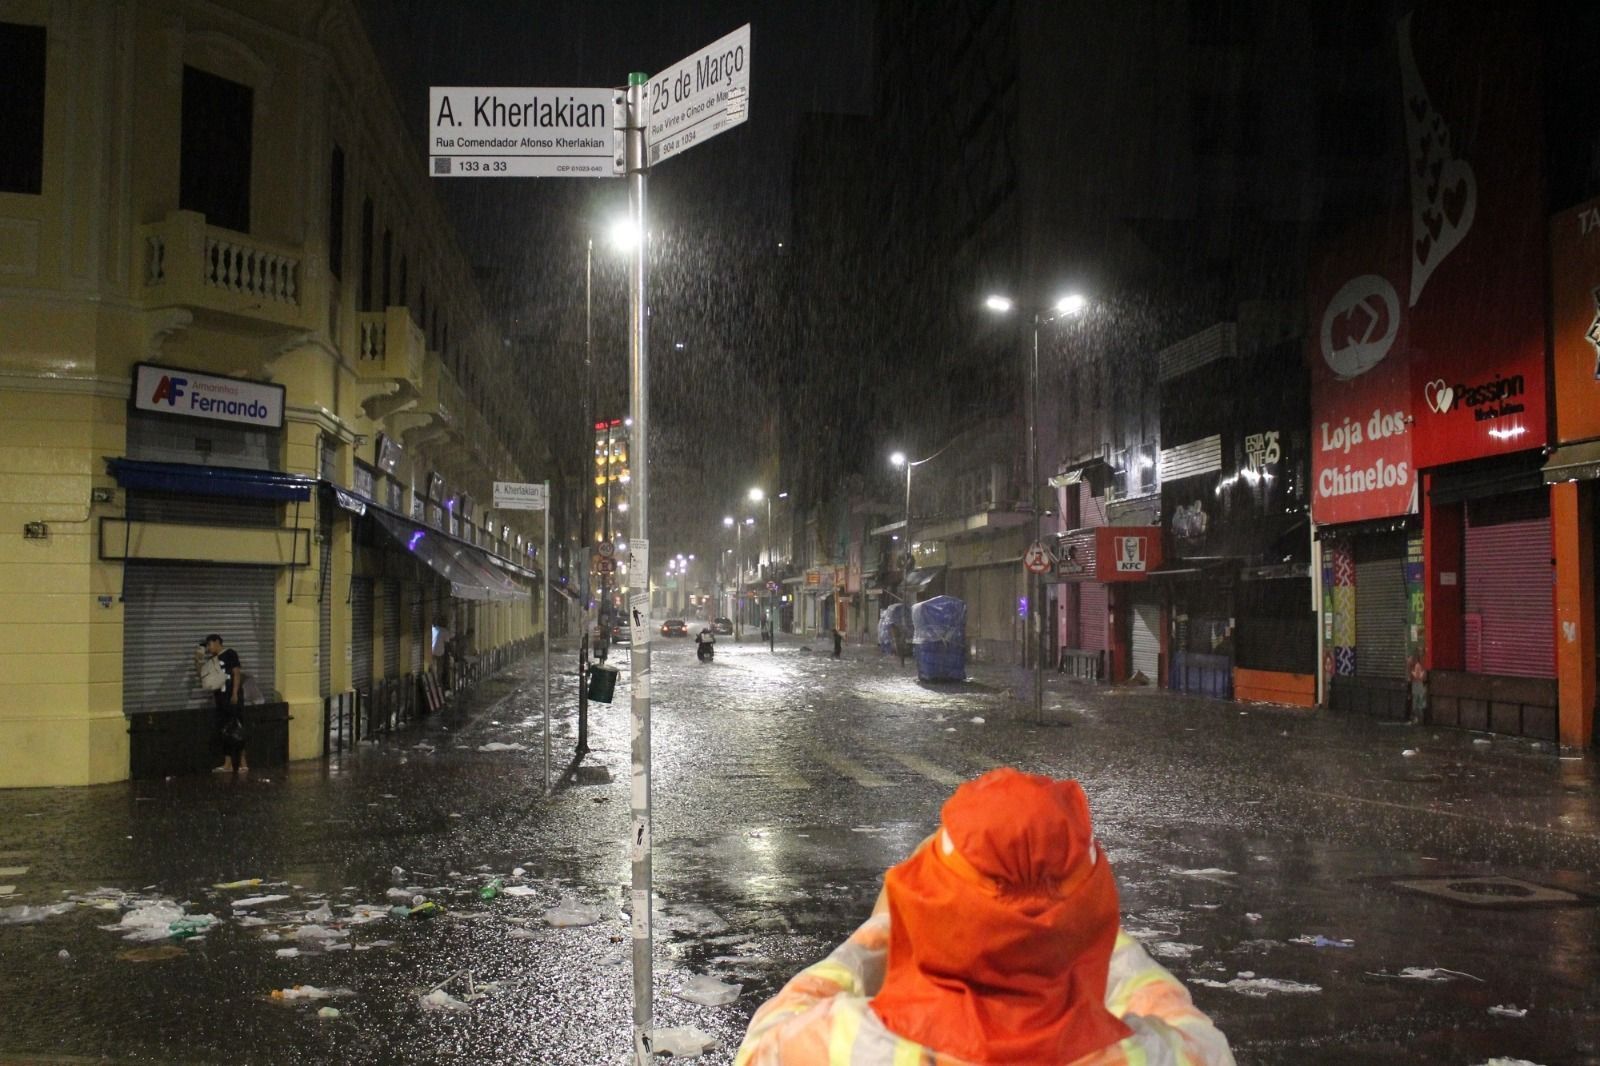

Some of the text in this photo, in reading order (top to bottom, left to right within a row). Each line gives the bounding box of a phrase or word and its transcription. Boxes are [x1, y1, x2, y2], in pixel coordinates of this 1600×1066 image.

[652, 78, 669, 115] 25
[674, 69, 691, 103] de
[696, 45, 744, 93] Março
[436, 95, 605, 127] A. Kherlakian
[652, 122, 664, 135] Rua
[664, 115, 680, 129] Vinte
[681, 112, 686, 121] e
[686, 104, 705, 119] Cinco
[706, 97, 715, 109] de
[436, 137, 605, 148] Rua Comendador Afonso Kherlakian
[459, 161, 507, 172] 133 a 33
[152, 375, 188, 407] AF
[190, 391, 268, 419] Fernando
[1453, 373, 1525, 411] Passion
[1321, 408, 1405, 454] Loja dos
[1319, 457, 1409, 498] Chinelos
[1121, 562, 1142, 570] KFC
